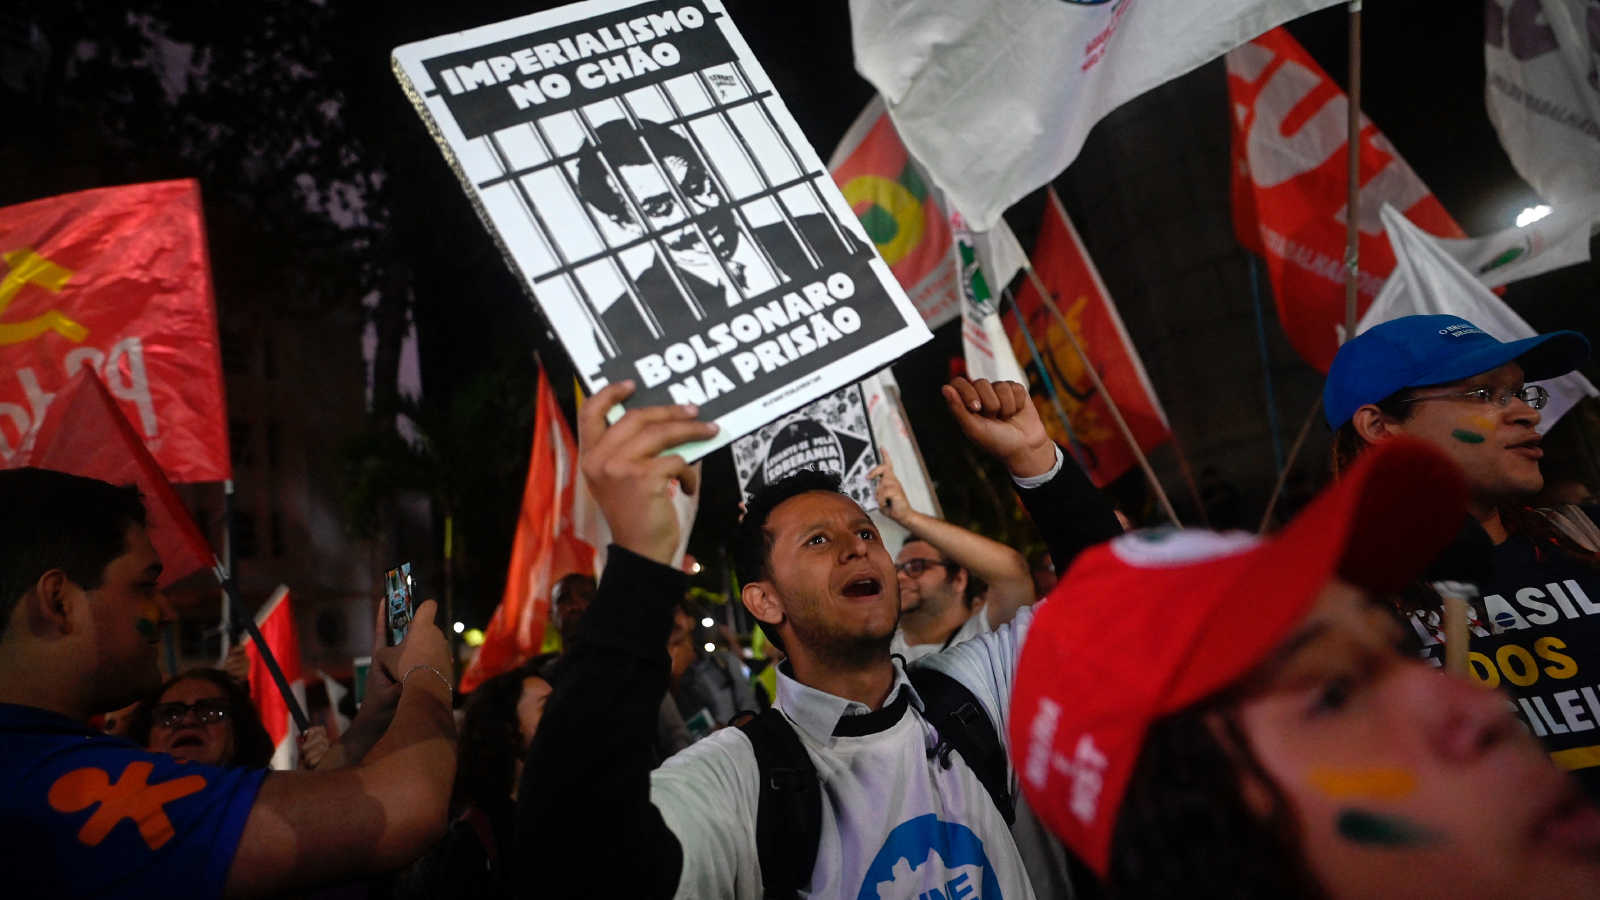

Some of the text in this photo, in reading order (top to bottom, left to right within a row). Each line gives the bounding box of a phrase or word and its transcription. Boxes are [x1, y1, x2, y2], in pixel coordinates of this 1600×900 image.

[440, 6, 704, 96] IMPERIALISMO
[507, 42, 681, 110] NO CHÃO
[634, 272, 856, 389] BOLSONARO
[668, 366, 736, 407] NA
[731, 306, 862, 384] PRISÃO
